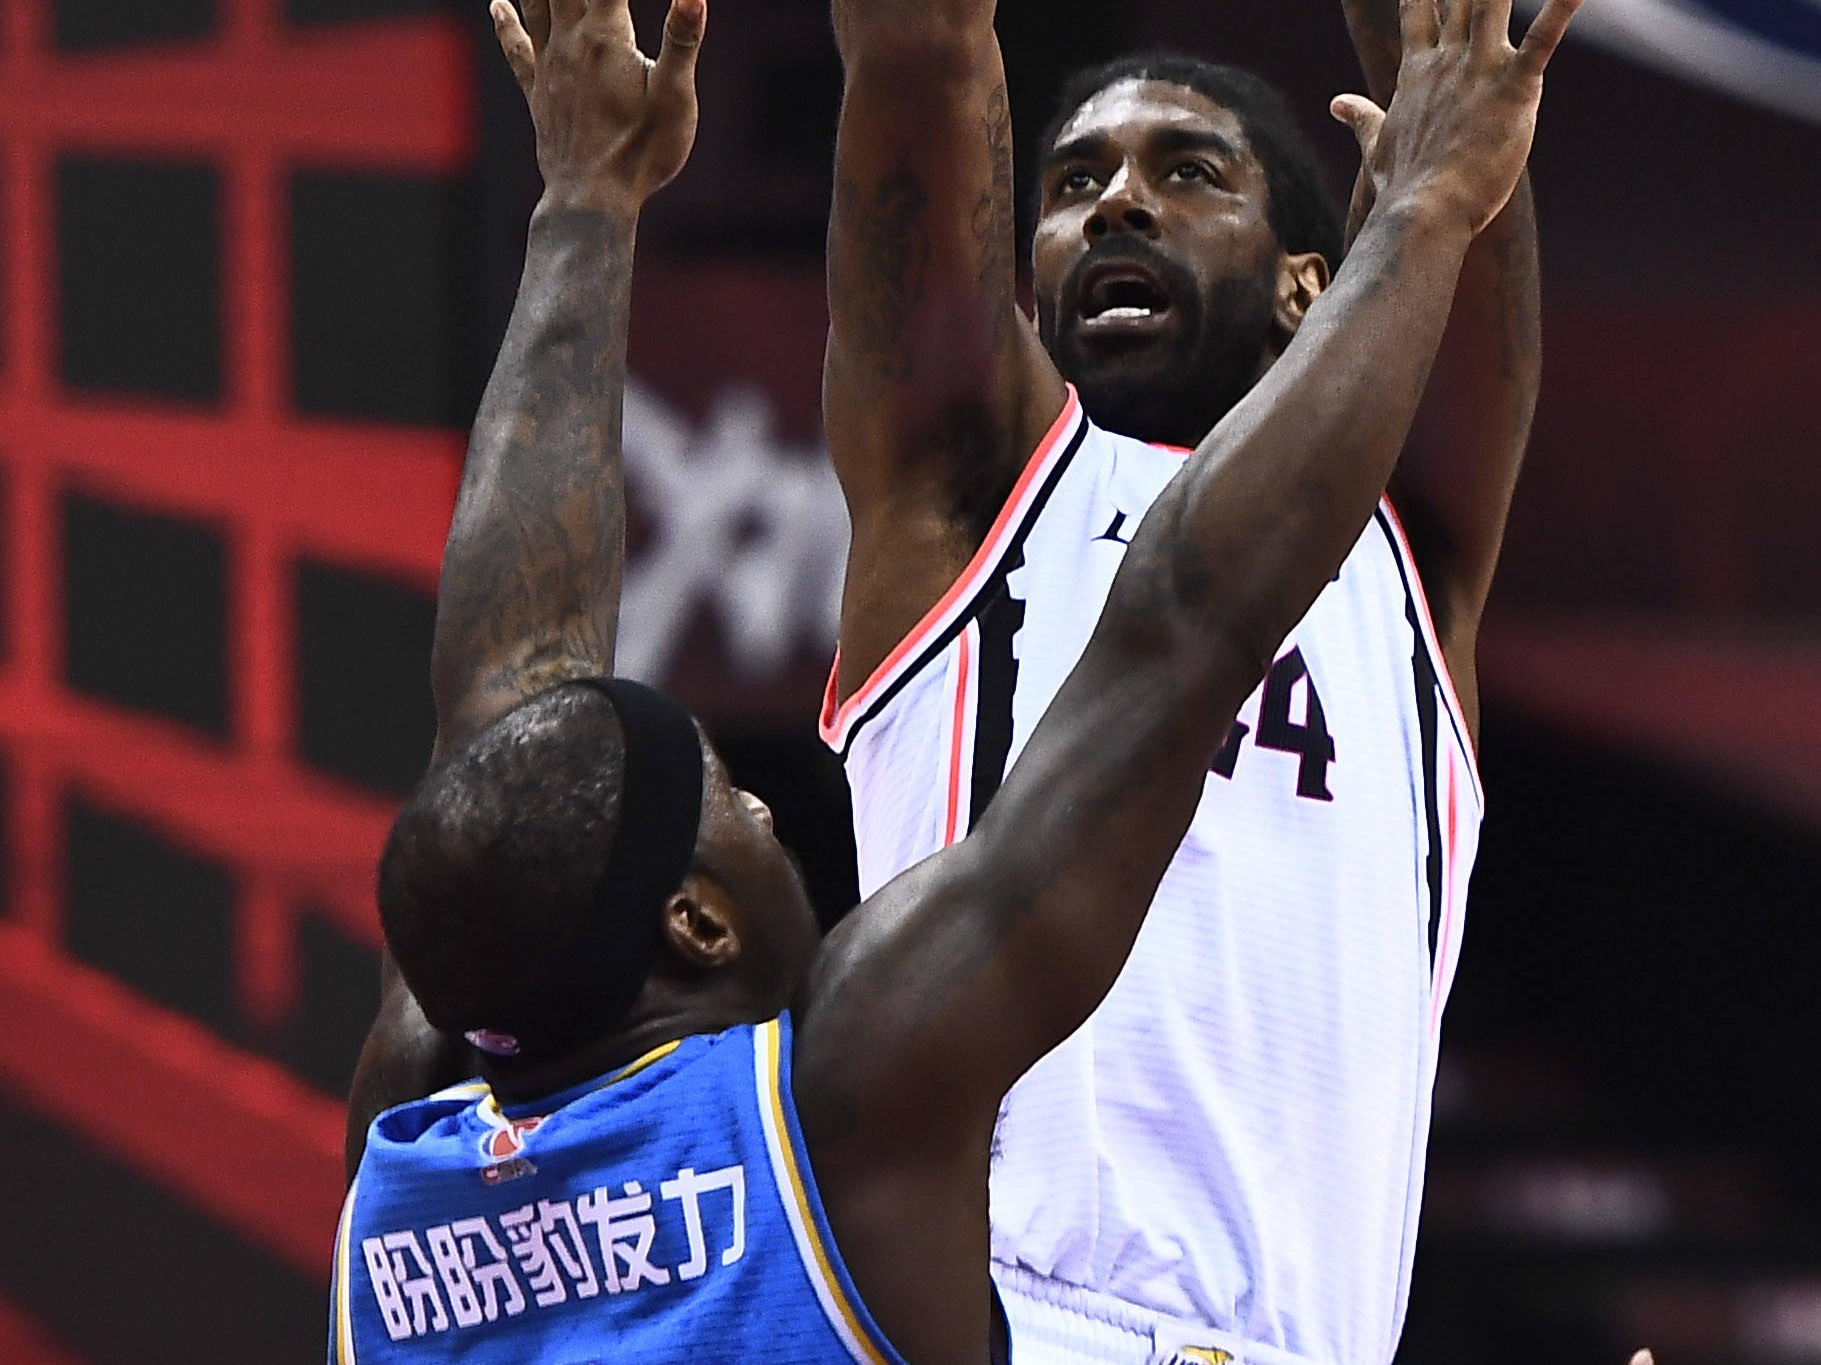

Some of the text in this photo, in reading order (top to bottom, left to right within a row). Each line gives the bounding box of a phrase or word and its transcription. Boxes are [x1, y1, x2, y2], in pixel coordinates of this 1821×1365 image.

[362, 1164, 745, 1342] 盼盼豹发力
